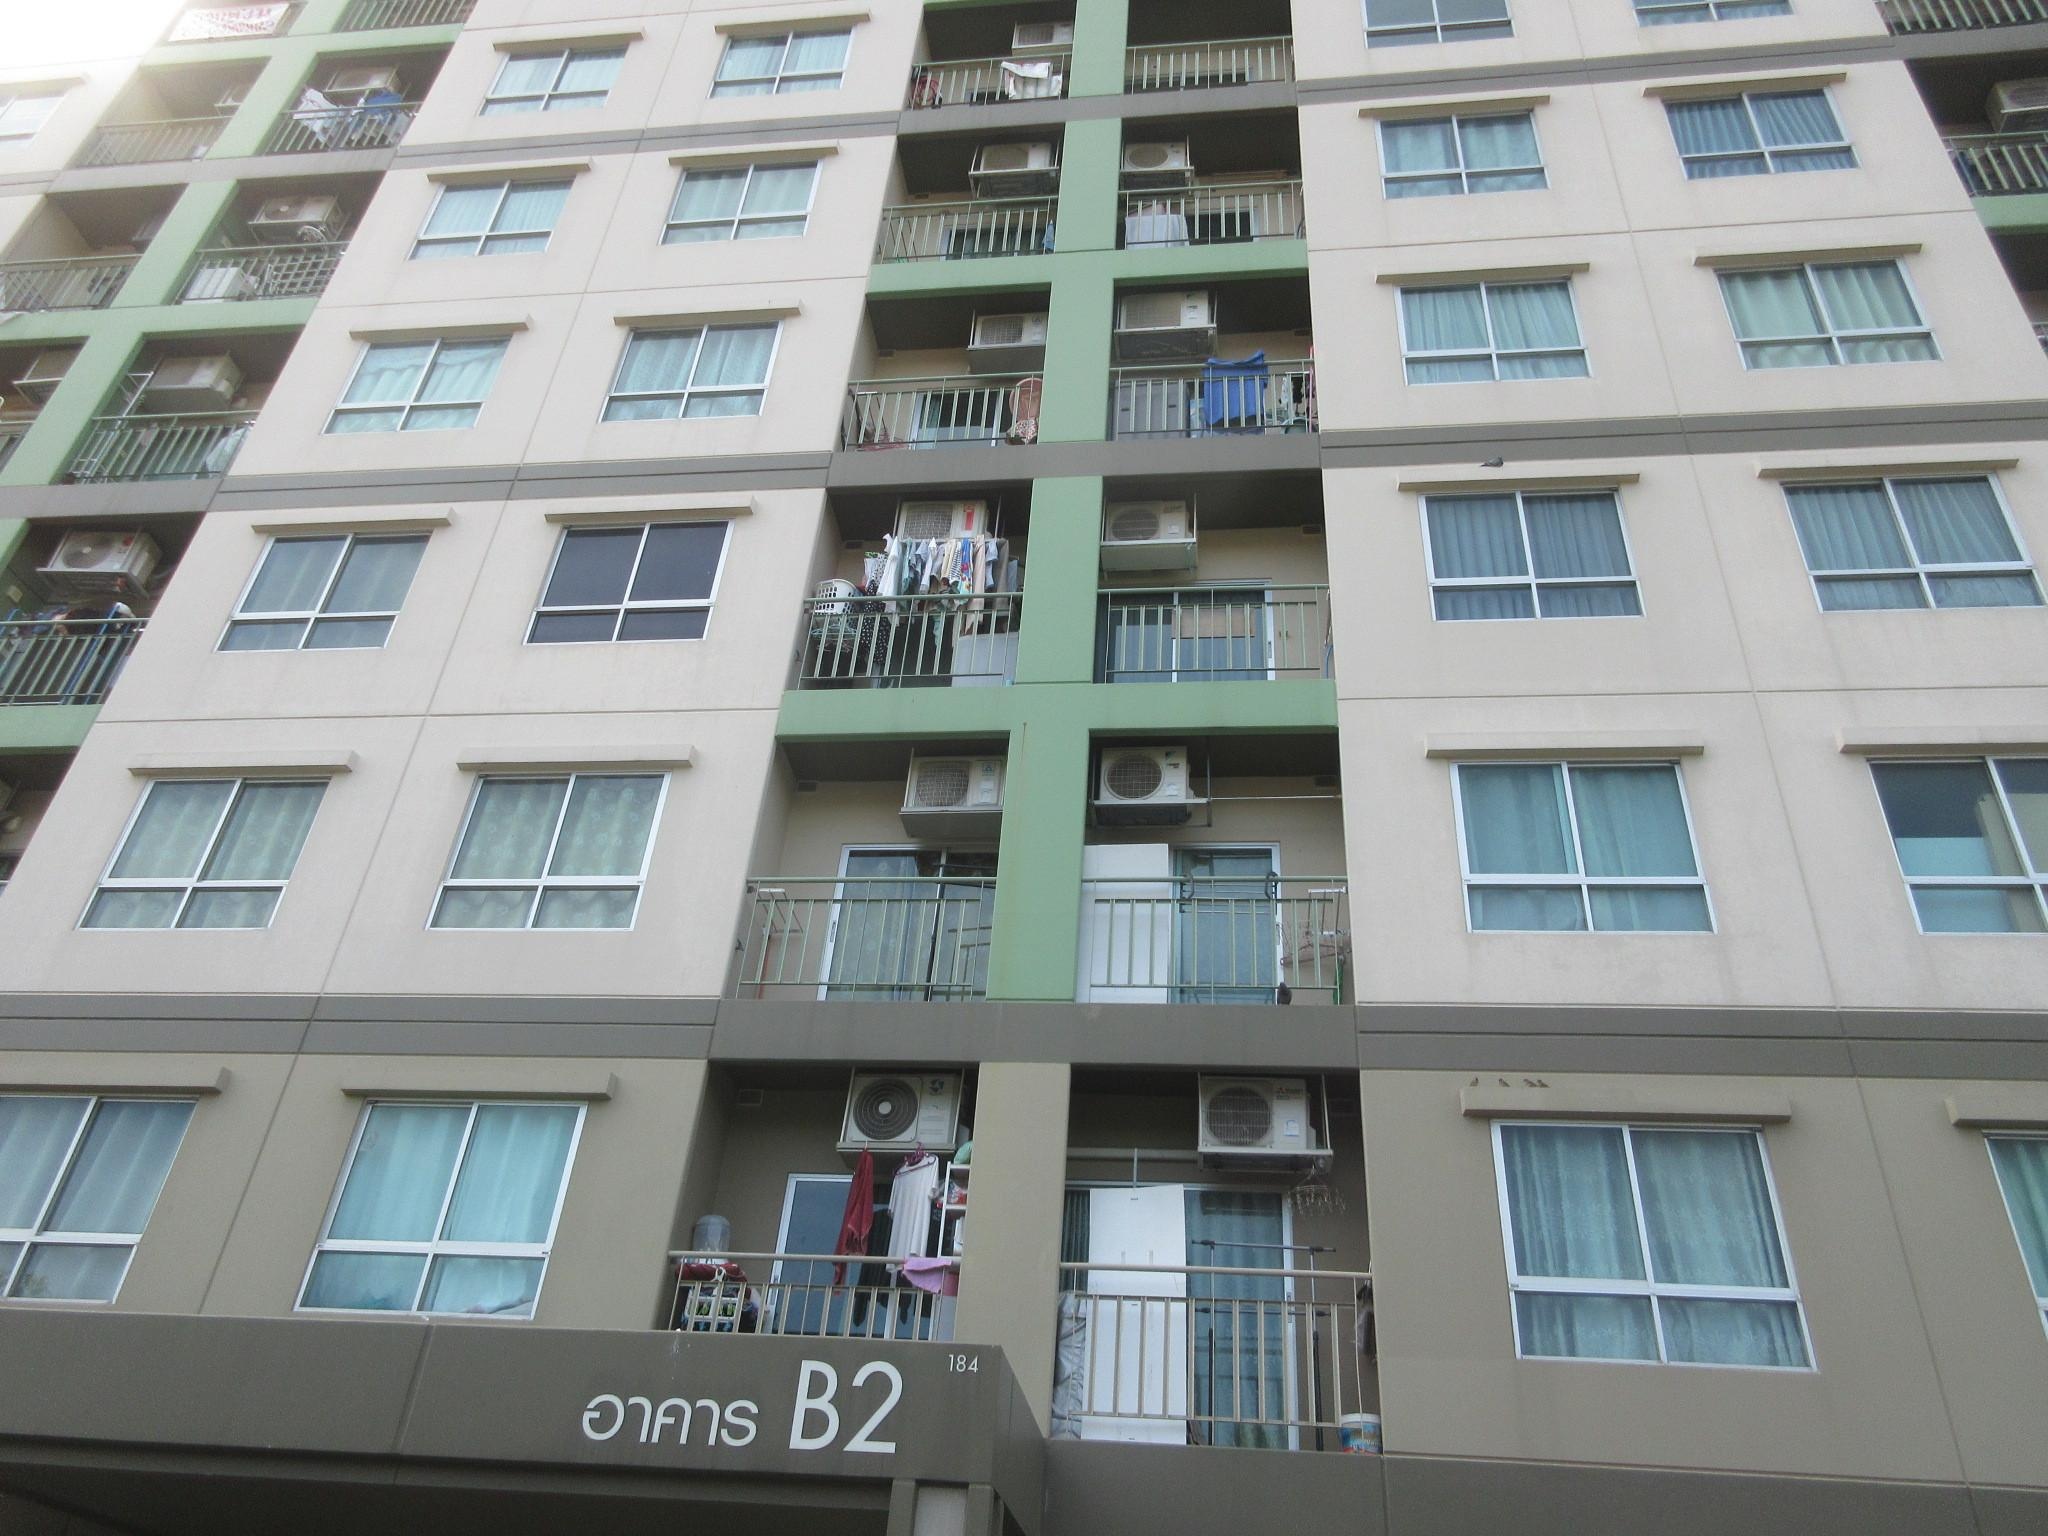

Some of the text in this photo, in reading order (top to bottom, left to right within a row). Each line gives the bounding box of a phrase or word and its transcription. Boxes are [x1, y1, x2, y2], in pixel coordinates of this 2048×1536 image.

[948, 1354, 979, 1373] 184
[582, 1359, 904, 1454] อาคาร B2
